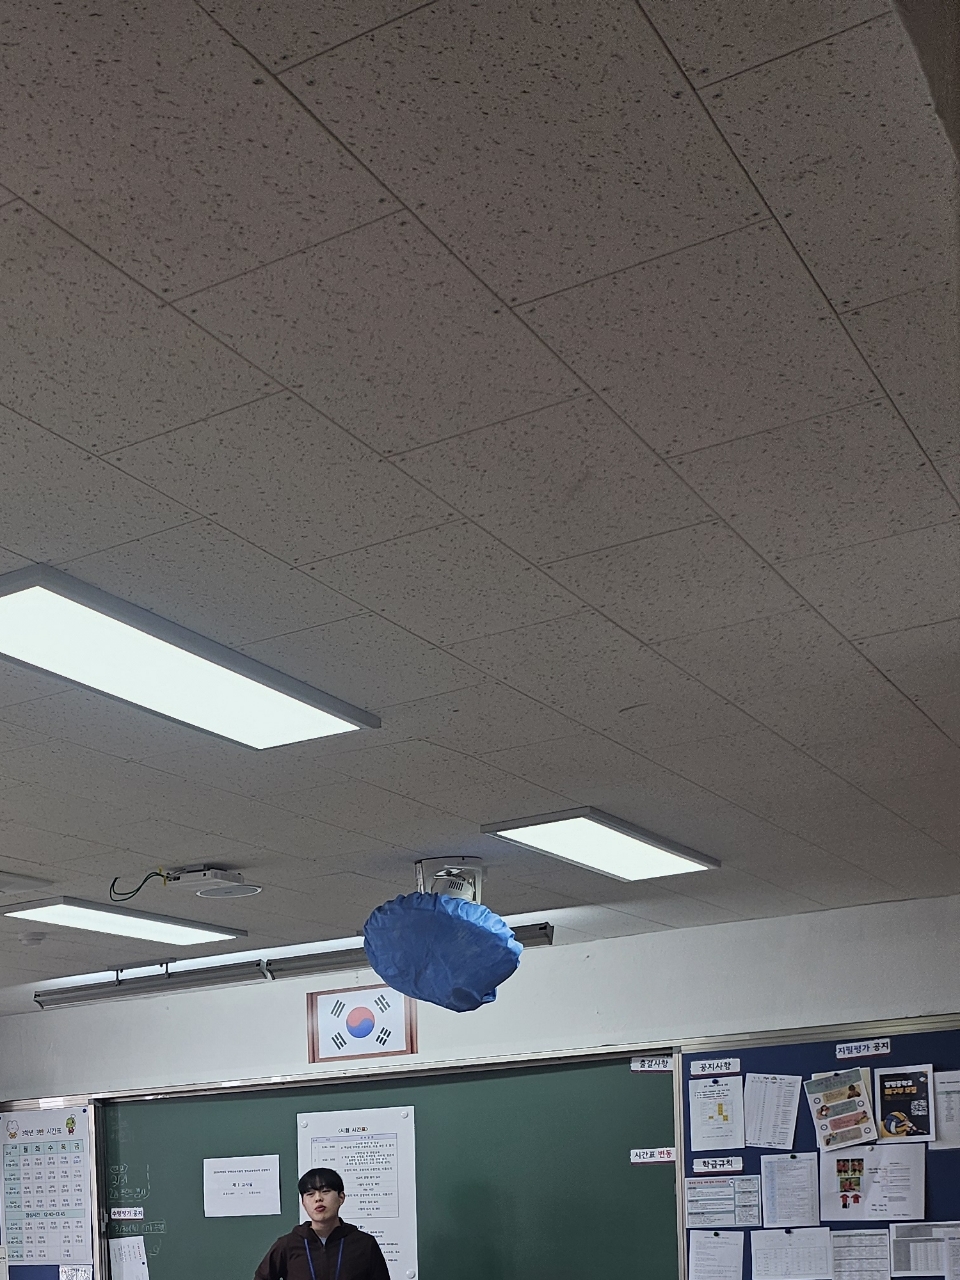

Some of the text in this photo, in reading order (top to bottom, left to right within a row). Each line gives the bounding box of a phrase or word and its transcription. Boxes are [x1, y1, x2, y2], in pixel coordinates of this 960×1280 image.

[838, 1041, 889, 1055] 지필평가 공지
[639, 1059, 669, 1068] 출결사항
[699, 1061, 732, 1072] 공지사항
[46, 1127, 62, 1136] 시간표
[60, 1143, 67, 1151] 목
[73, 1142, 80, 1150] 금
[634, 1149, 673, 1160] 시간표 변동
[702, 1158, 734, 1169] 학급규칙
[112, 1209, 143, 1219] 수행평가 공지
